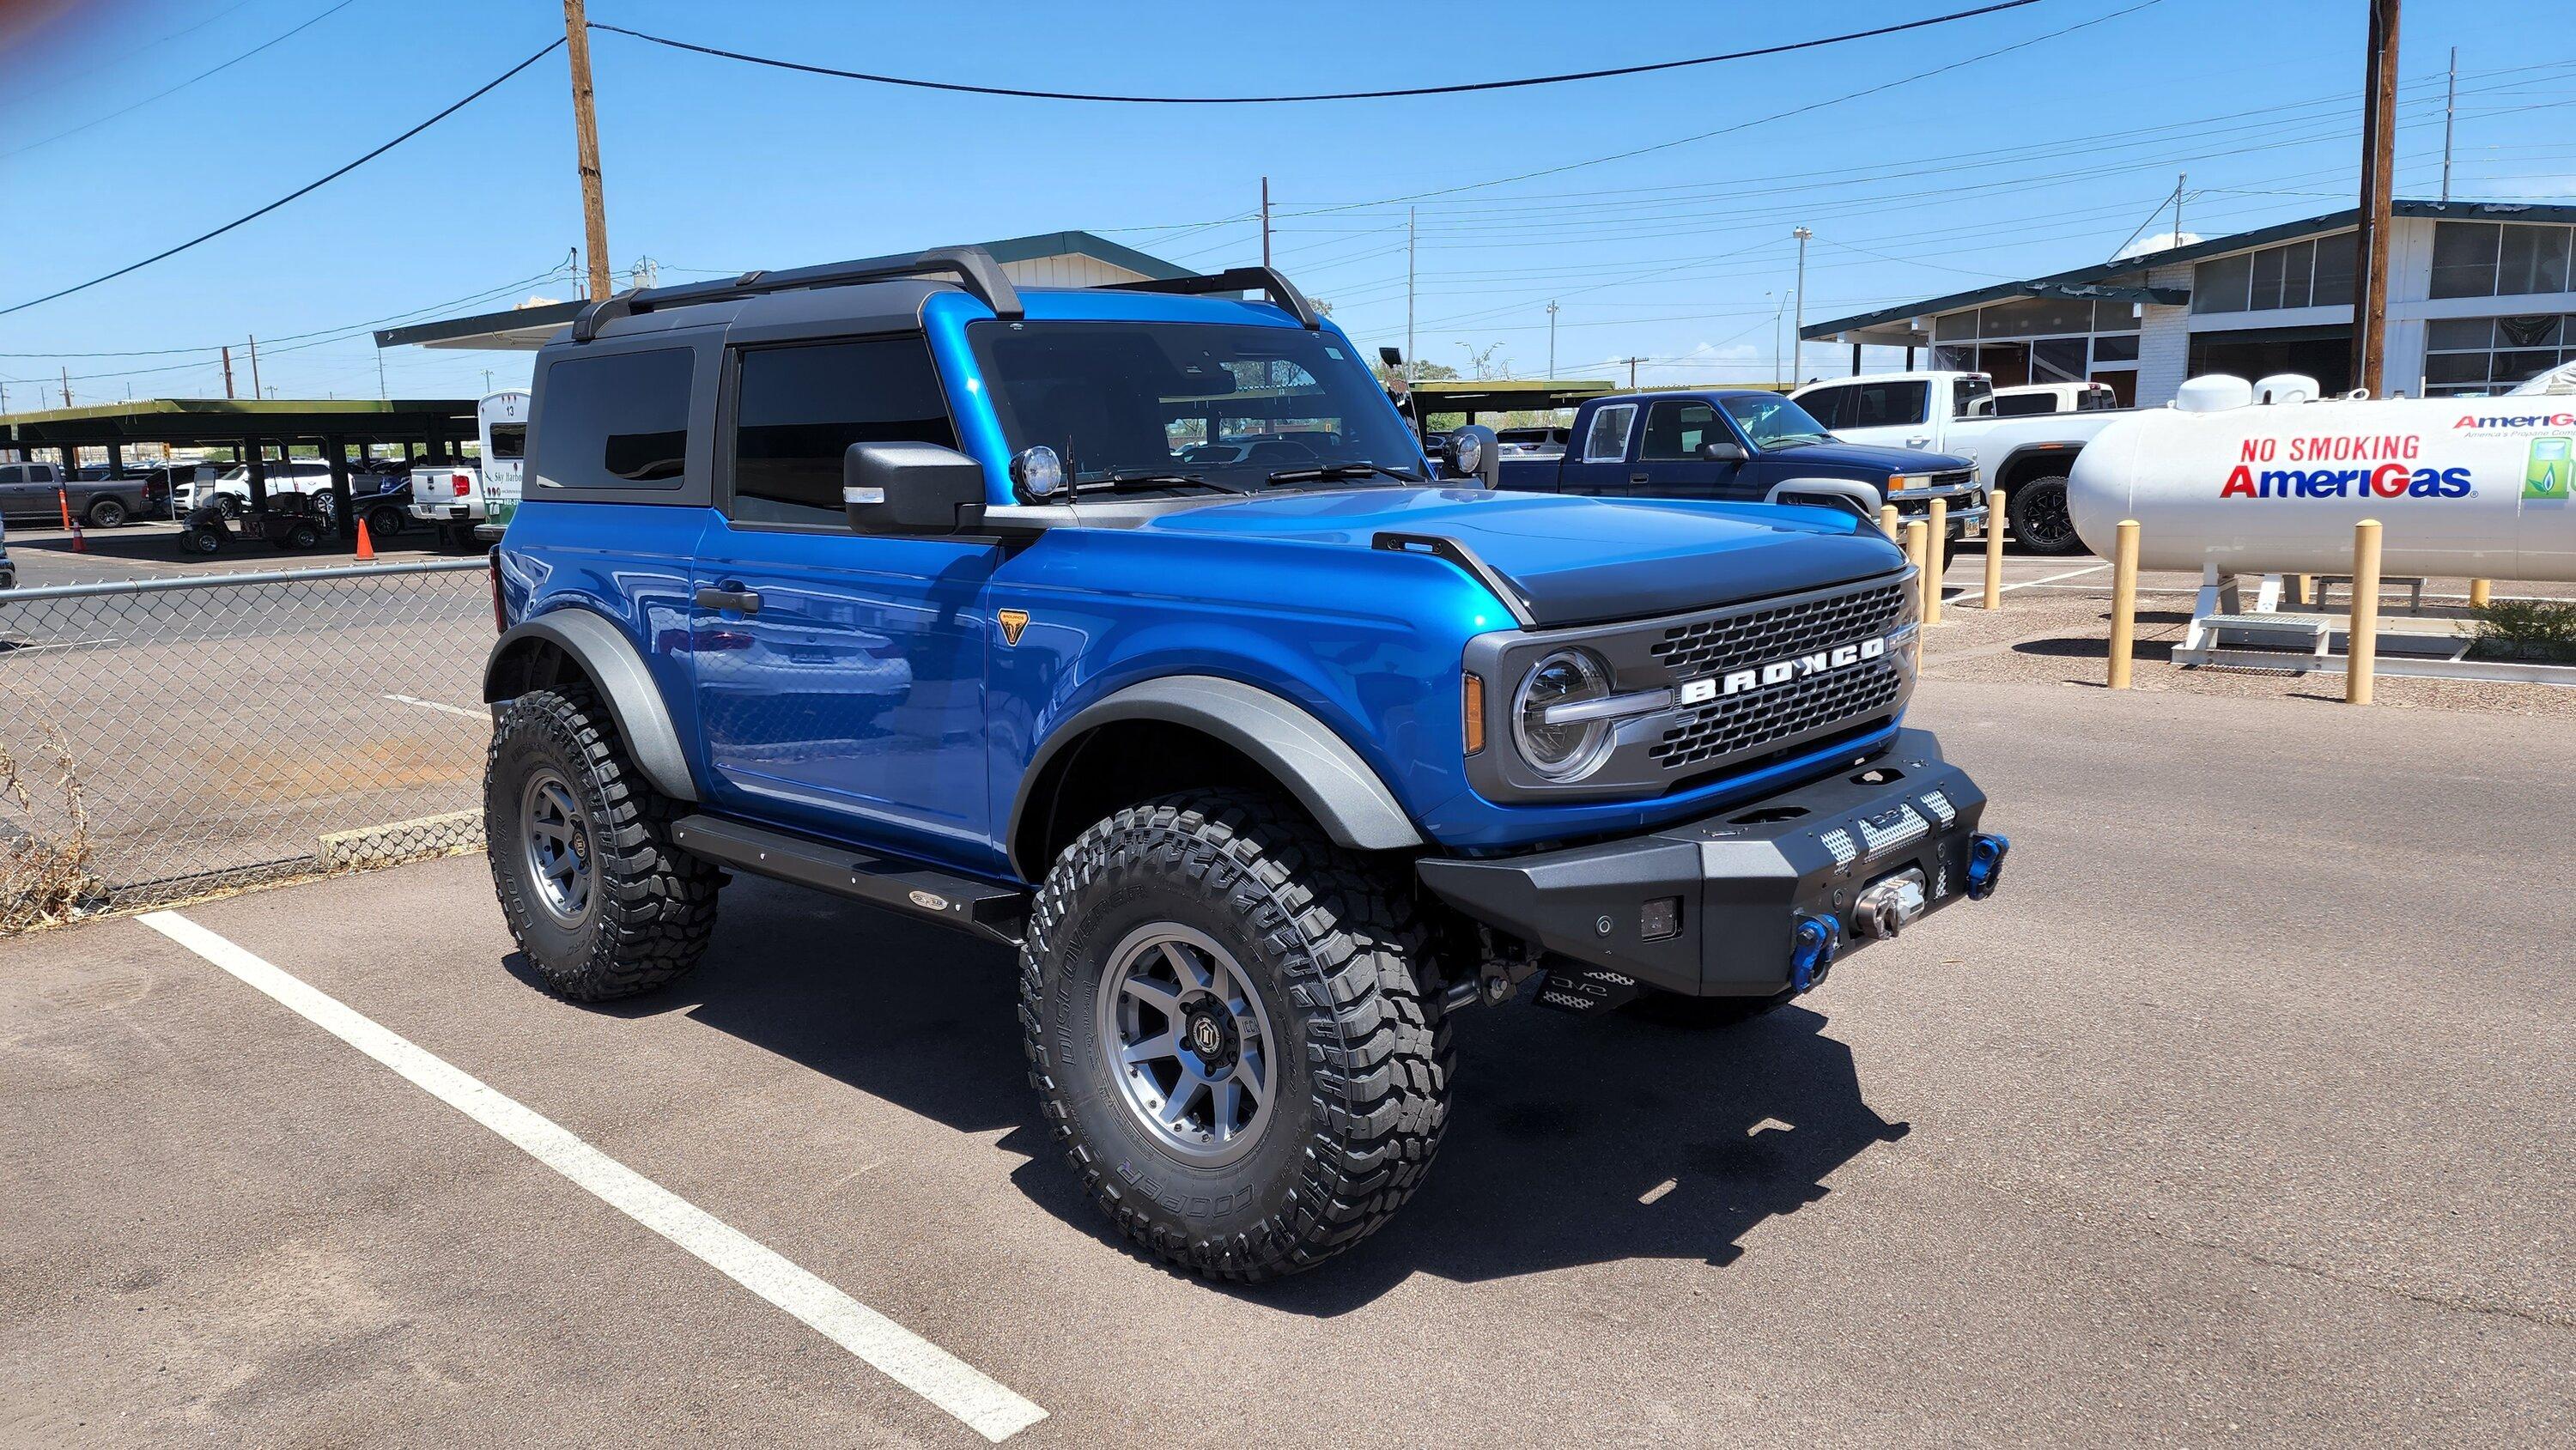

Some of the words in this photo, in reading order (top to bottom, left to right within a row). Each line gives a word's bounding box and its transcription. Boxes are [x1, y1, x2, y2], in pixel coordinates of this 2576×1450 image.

[507, 406, 514, 416] 13
[2452, 413, 2576, 429] AmeriG
[2240, 439, 2276, 463] NO
[2289, 434, 2421, 462] SMOKING
[495, 471, 504, 484] Sky
[1680, 637, 1885, 705] BRONCO
[1115, 1156, 1255, 1219] COOPER
